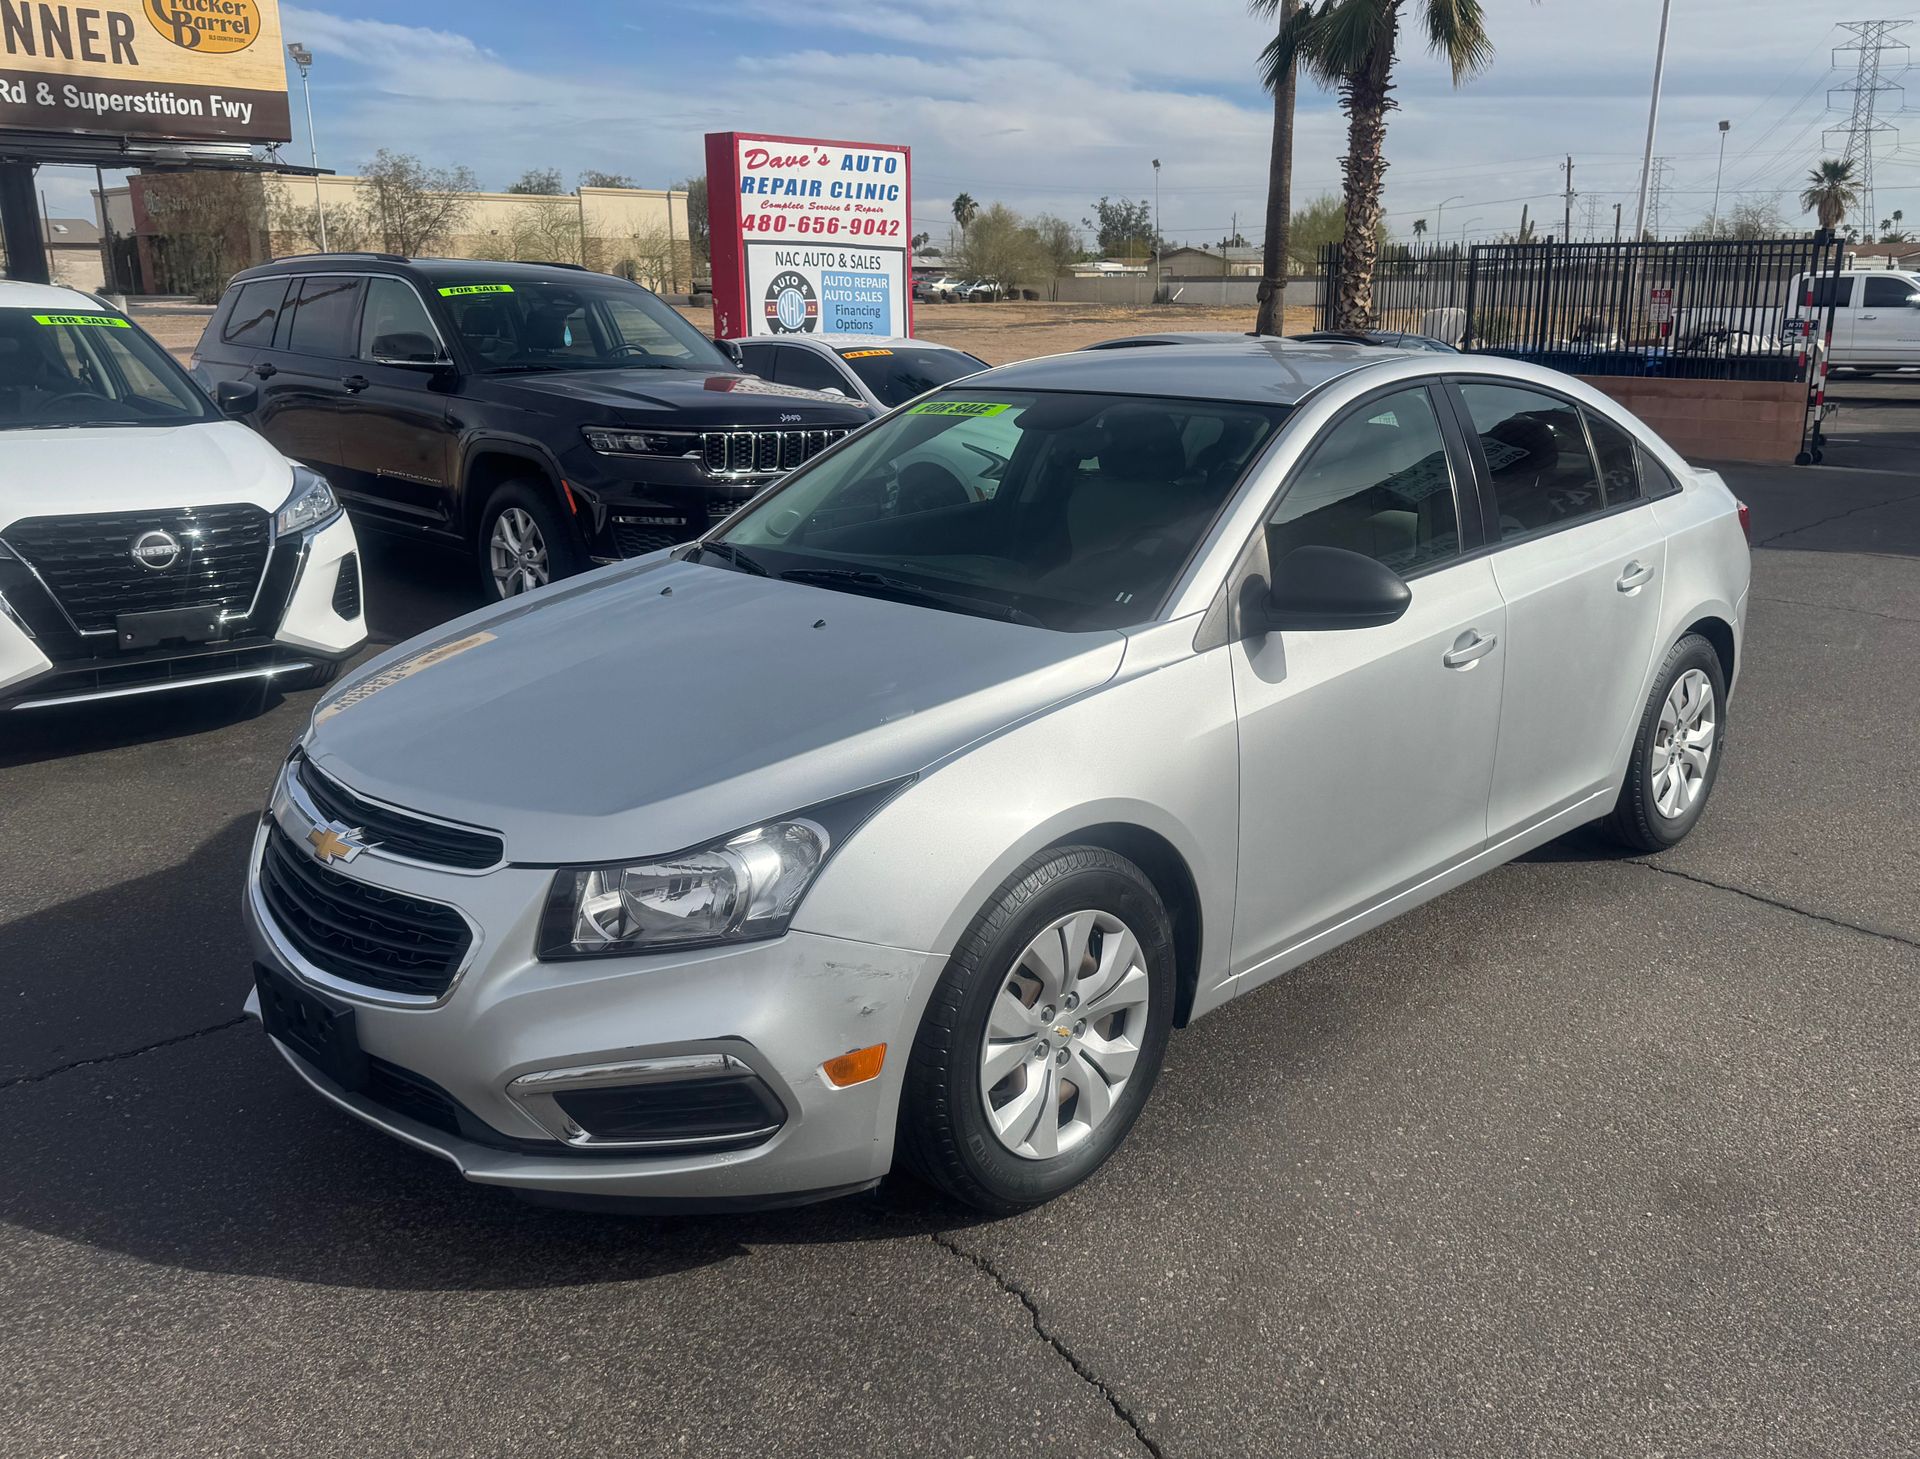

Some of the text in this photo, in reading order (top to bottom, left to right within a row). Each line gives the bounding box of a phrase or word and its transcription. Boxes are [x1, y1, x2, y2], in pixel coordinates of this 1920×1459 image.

[170, 10, 251, 48] Barrel
[0, 79, 253, 124] Rd & Superstition Fwy
[744, 147, 897, 174] Dave's AUTO
[741, 176, 899, 202] REPAIR CLINIC
[760, 200, 884, 214] Complete Service & Repair
[741, 214, 900, 237] 480-656-9042
[775, 251, 881, 270] NAC AUTO & SALES
[772, 275, 808, 295] AUTO &
[823, 275, 888, 289] AUTO REPAIR
[824, 289, 883, 303] AUTO SALES
[835, 304, 881, 318] Financing
[47, 316, 118, 326] FOR SALE
[836, 319, 873, 332] Options
[915, 403, 998, 415] FOR SALE
[780, 413, 802, 422] Jeep
[132, 544, 180, 557] NISSAN
